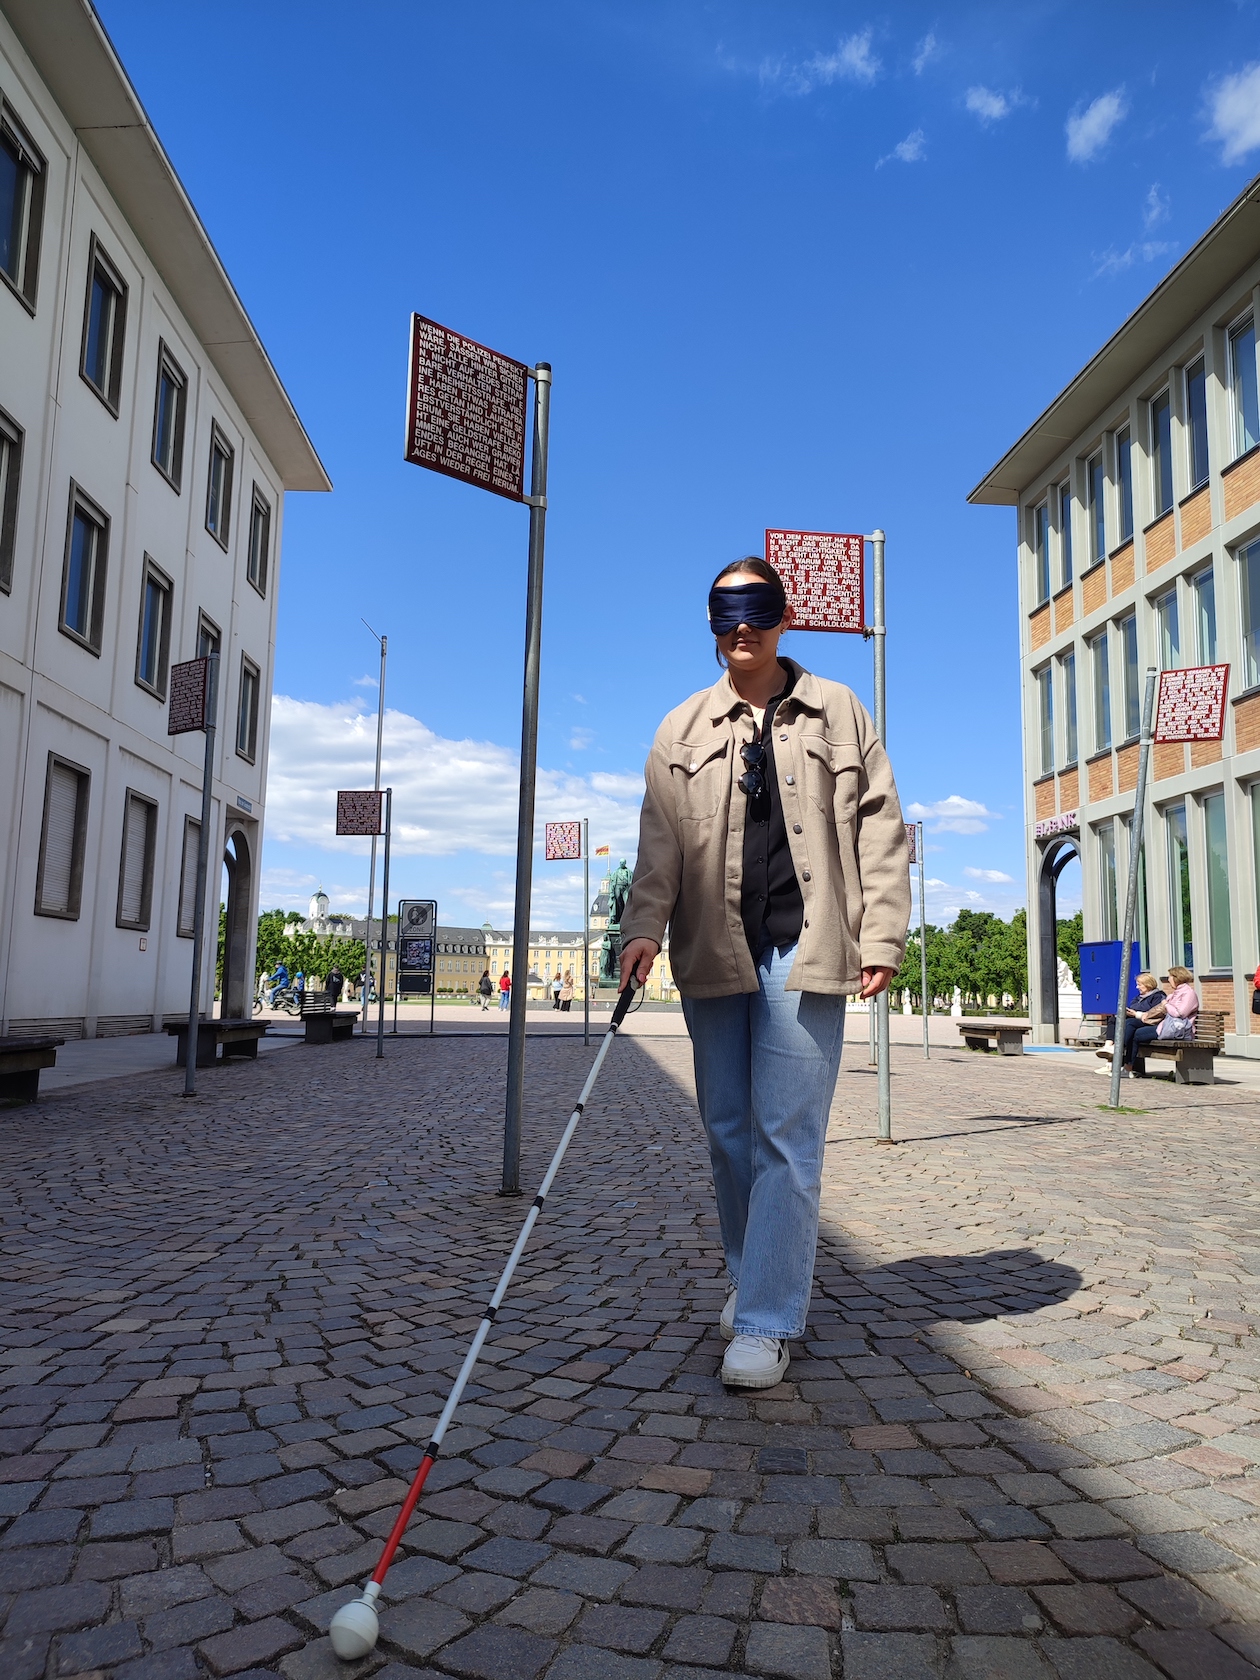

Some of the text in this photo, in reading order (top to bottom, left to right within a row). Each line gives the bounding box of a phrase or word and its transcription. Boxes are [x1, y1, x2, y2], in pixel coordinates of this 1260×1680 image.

[419, 339, 523, 393] NICHT ALLE HINTER GITTER
[419, 348, 524, 401] N. NICHT AUF JEDES STRAF
[420, 322, 524, 377] WENN DIE POLIZEI PERFEKT
[483, 358, 497, 372] WIR
[499, 366, 523, 385] SICHER
[418, 365, 433, 378] INE
[509, 404, 523, 418] VIEL
[418, 374, 523, 426] E HABEN ETWAS STRAFBA
[419, 356, 523, 409] BARE VERHALTEN STEHT E
[417, 391, 522, 443] LBSTVERSTÄNDLICH FREI H
[417, 400, 521, 450] ERUM. SIE HABEN VIELLEIC
[418, 383, 522, 434] RES GETAN UND LAUFEN SE
[415, 428, 444, 445] ENDES
[448, 439, 491, 464] BEGANGEN
[416, 409, 521, 459] HT EINE GELDSTRAFE BEKO
[416, 418, 520, 467] MMEN. AUCH WER GRAVIER
[414, 437, 520, 485] UFT IN DER REGEL EINES T
[414, 446, 519, 494] AGES WIEDER FREI HERUM.
[793, 546, 846, 555] GERECHTIGKEIT
[809, 571, 860, 580] SCHNELLVERFA
[826, 590, 860, 598] EIGENTLIC
